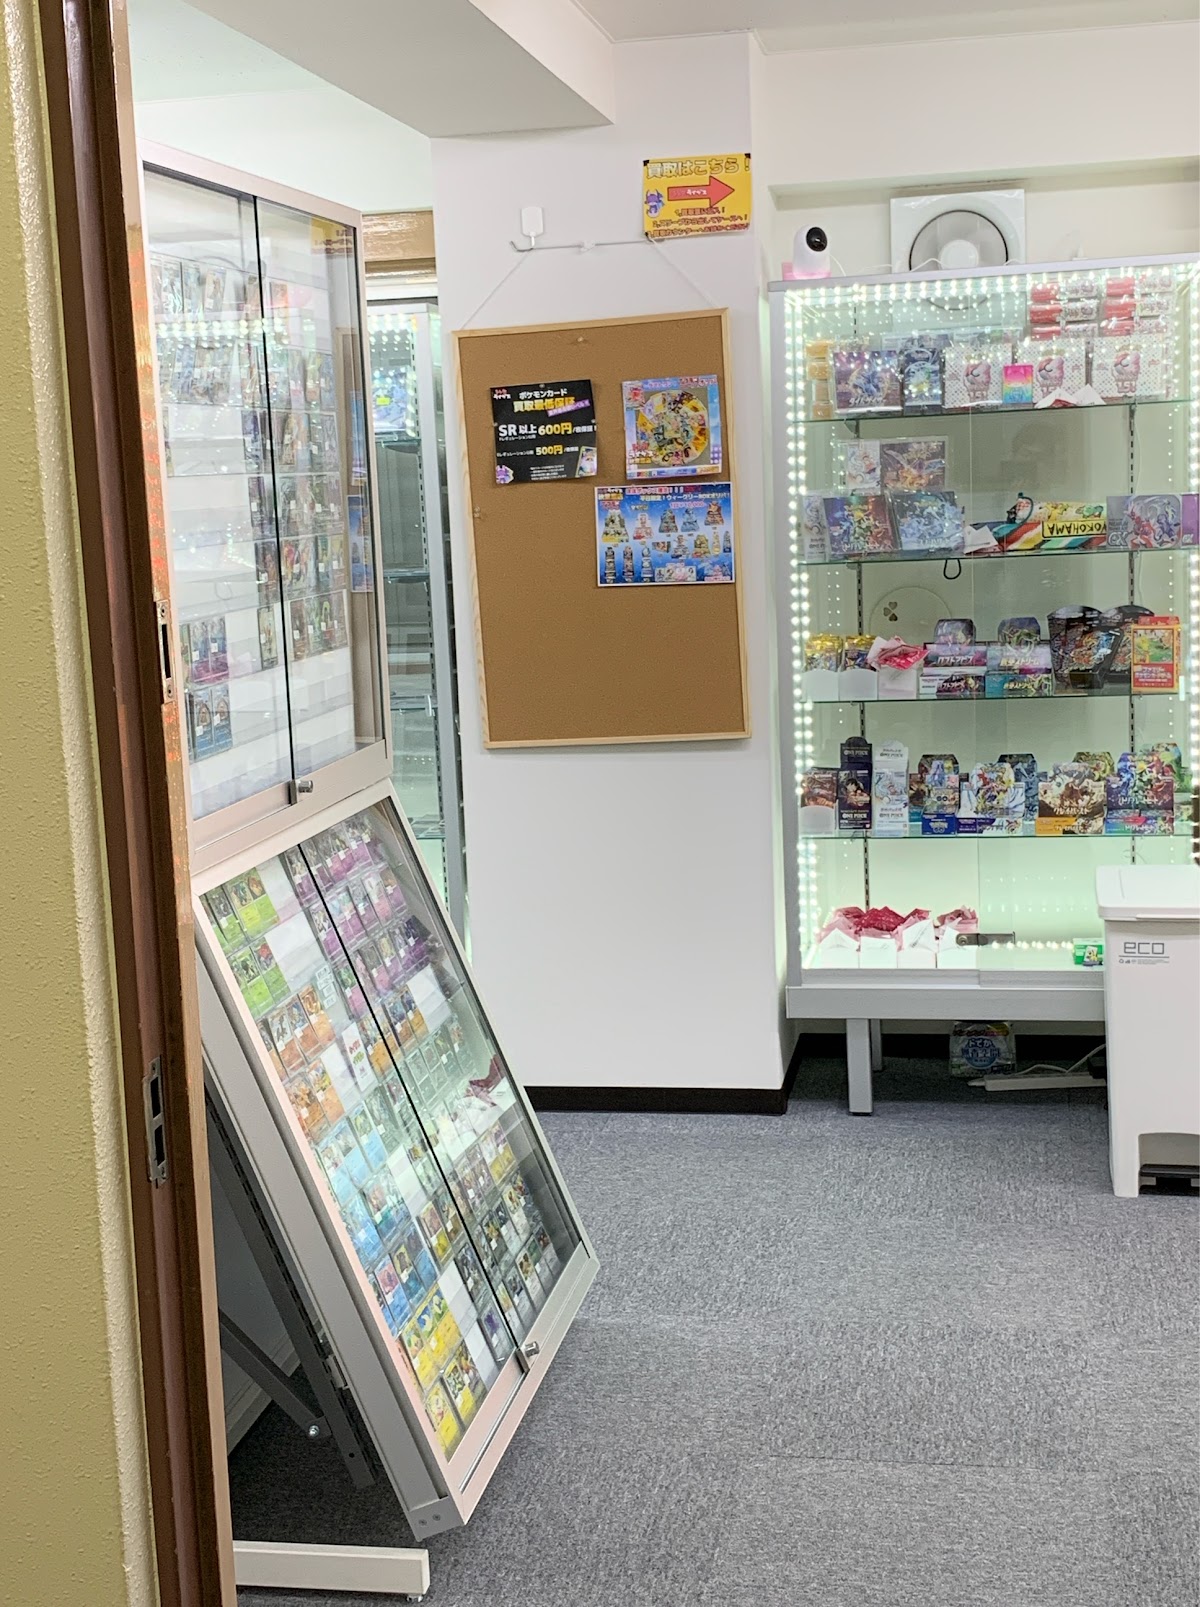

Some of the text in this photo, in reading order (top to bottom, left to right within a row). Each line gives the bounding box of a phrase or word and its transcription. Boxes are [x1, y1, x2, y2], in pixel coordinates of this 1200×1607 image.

[519, 388, 568, 399] ポケモンカード
[498, 423, 518, 437] SR
[518, 424, 538, 435] 以上
[538, 421, 573, 436] 600円
[535, 444, 563, 456] 500円
[1047, 521, 1107, 536] YOKOHAMA
[1123, 941, 1165, 955] eco
